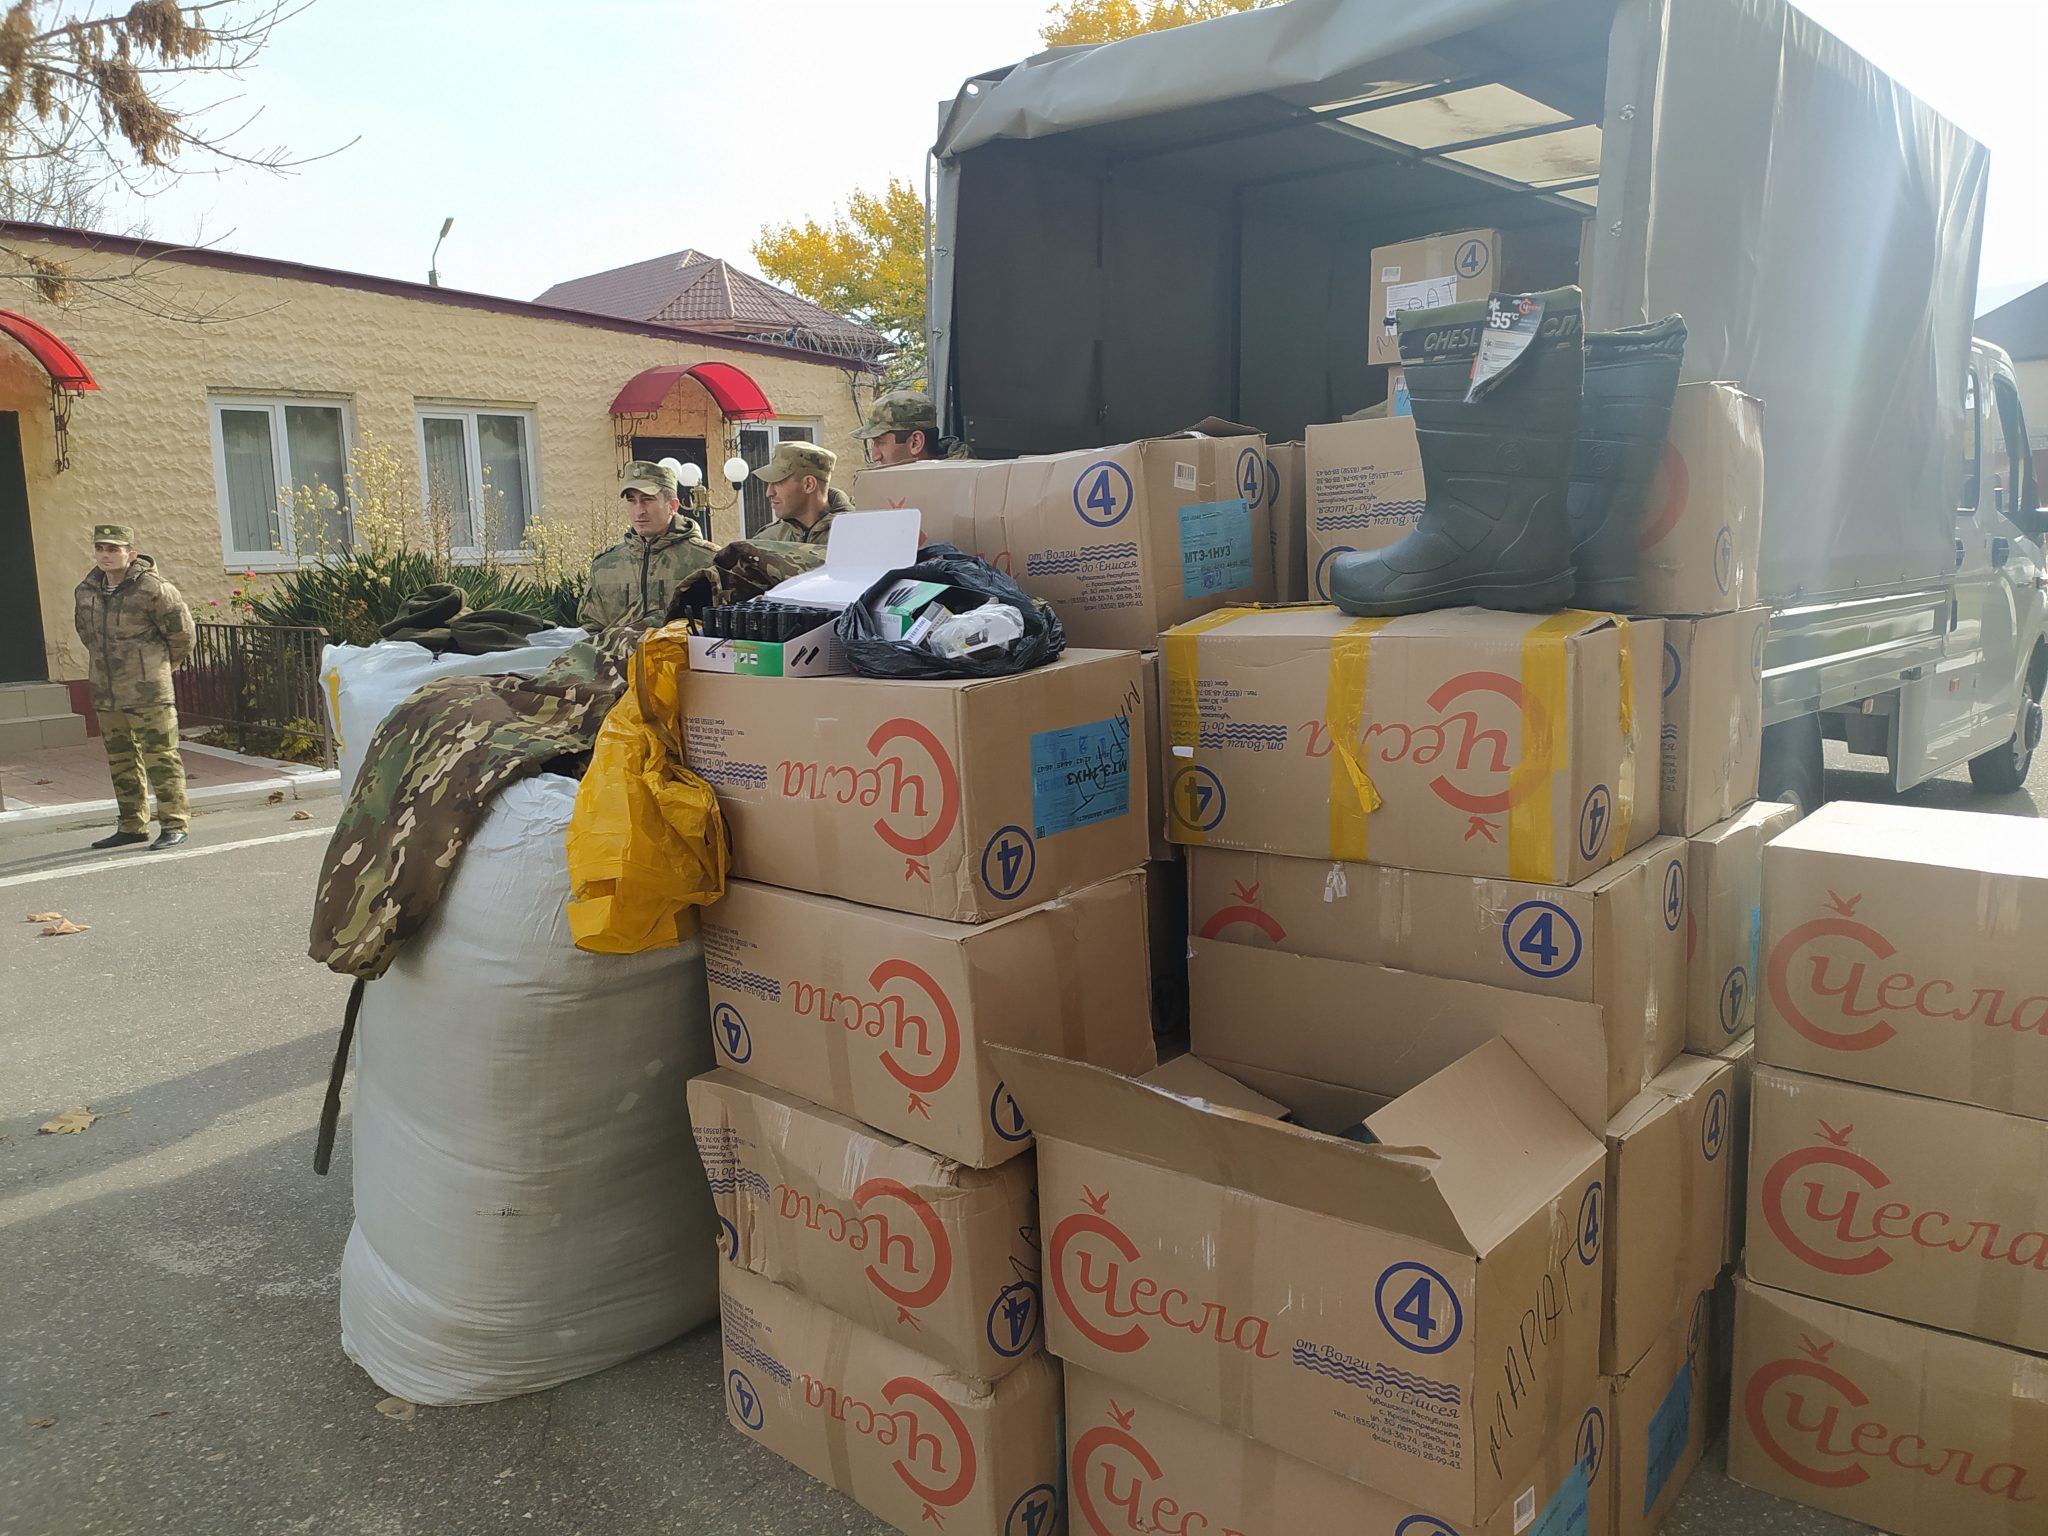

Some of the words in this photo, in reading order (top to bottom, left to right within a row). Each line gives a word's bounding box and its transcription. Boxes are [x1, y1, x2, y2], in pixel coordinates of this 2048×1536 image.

[1461, 242, 1480, 273] 4
[1423, 327, 1479, 352] CHESL
[1087, 470, 1117, 516] 4
[1243, 456, 1258, 499] 4
[1318, 504, 1358, 515] Енисея
[1360, 503, 1372, 514] до
[1043, 549, 1077, 560] Волги
[1081, 562, 1094, 573] до
[1095, 560, 1138, 572] Енисея
[1211, 721, 1225, 733] до
[1227, 740, 1265, 753] Волги
[1266, 741, 1284, 751] от
[1588, 798, 1605, 850] 4
[997, 839, 1024, 890] 4
[1668, 869, 1680, 917] 4
[1519, 912, 1558, 966] 4
[722, 1013, 741, 1054] 4
[1707, 1106, 1721, 1148] 4
[722, 1167, 736, 1179] до
[1584, 1192, 1598, 1248] 4
[1395, 1277, 1437, 1340] 4
[1296, 1338, 1319, 1353] от
[1320, 1344, 1372, 1371] Волги
[1374, 1381, 1393, 1398] до
[1397, 1390, 1461, 1419] Енисея
[1353, 1415, 1379, 1432] (8352)
[1393, 1439, 1421, 1458] (8352)
